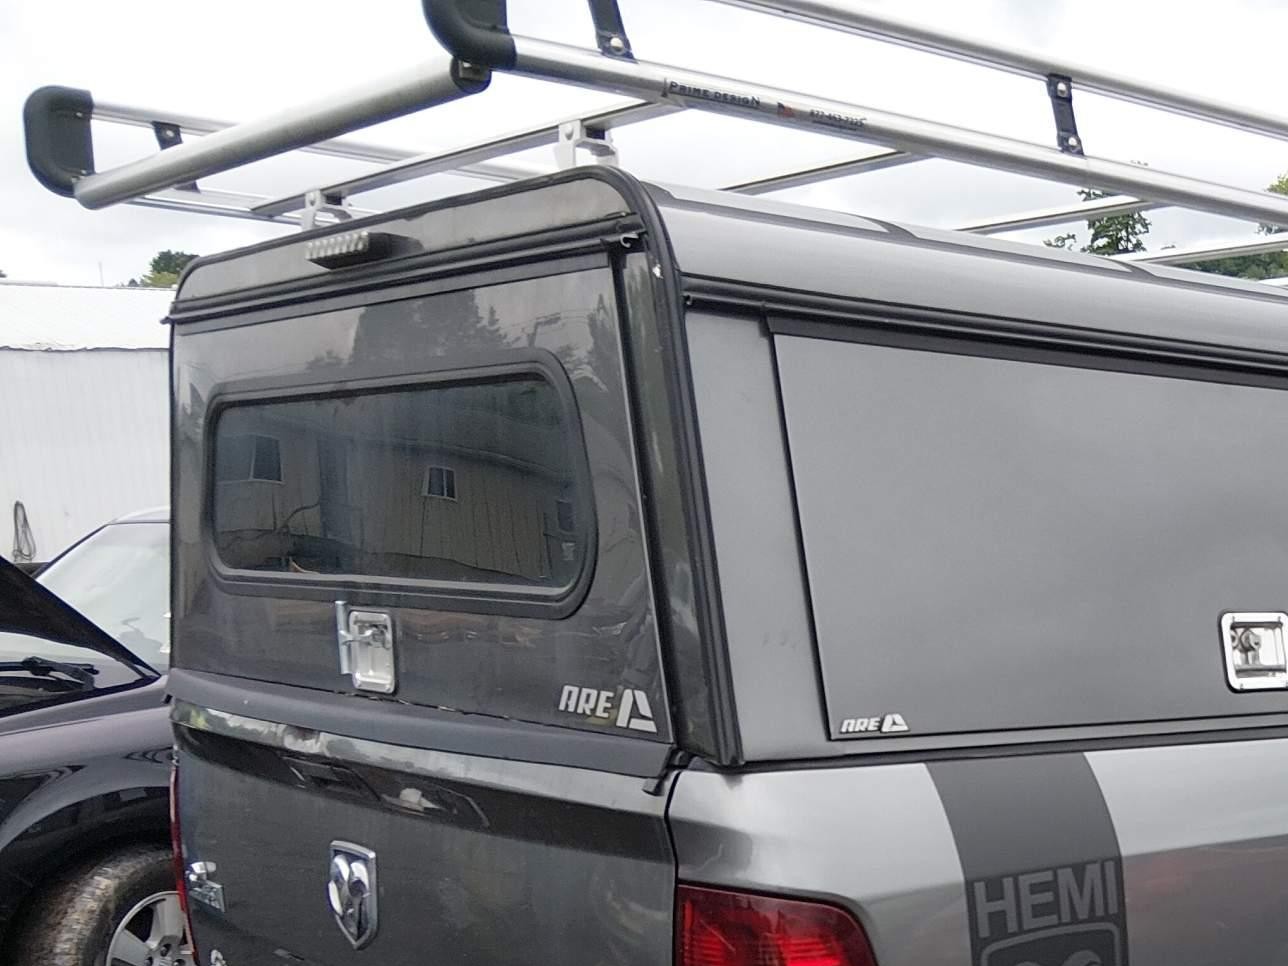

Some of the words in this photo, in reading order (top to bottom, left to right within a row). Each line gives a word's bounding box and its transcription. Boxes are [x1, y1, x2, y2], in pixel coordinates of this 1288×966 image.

[669, 81, 709, 99] PRIME
[714, 91, 761, 108] DESIGN
[558, 685, 614, 718] ARE
[973, 860, 1119, 938] HEMI
